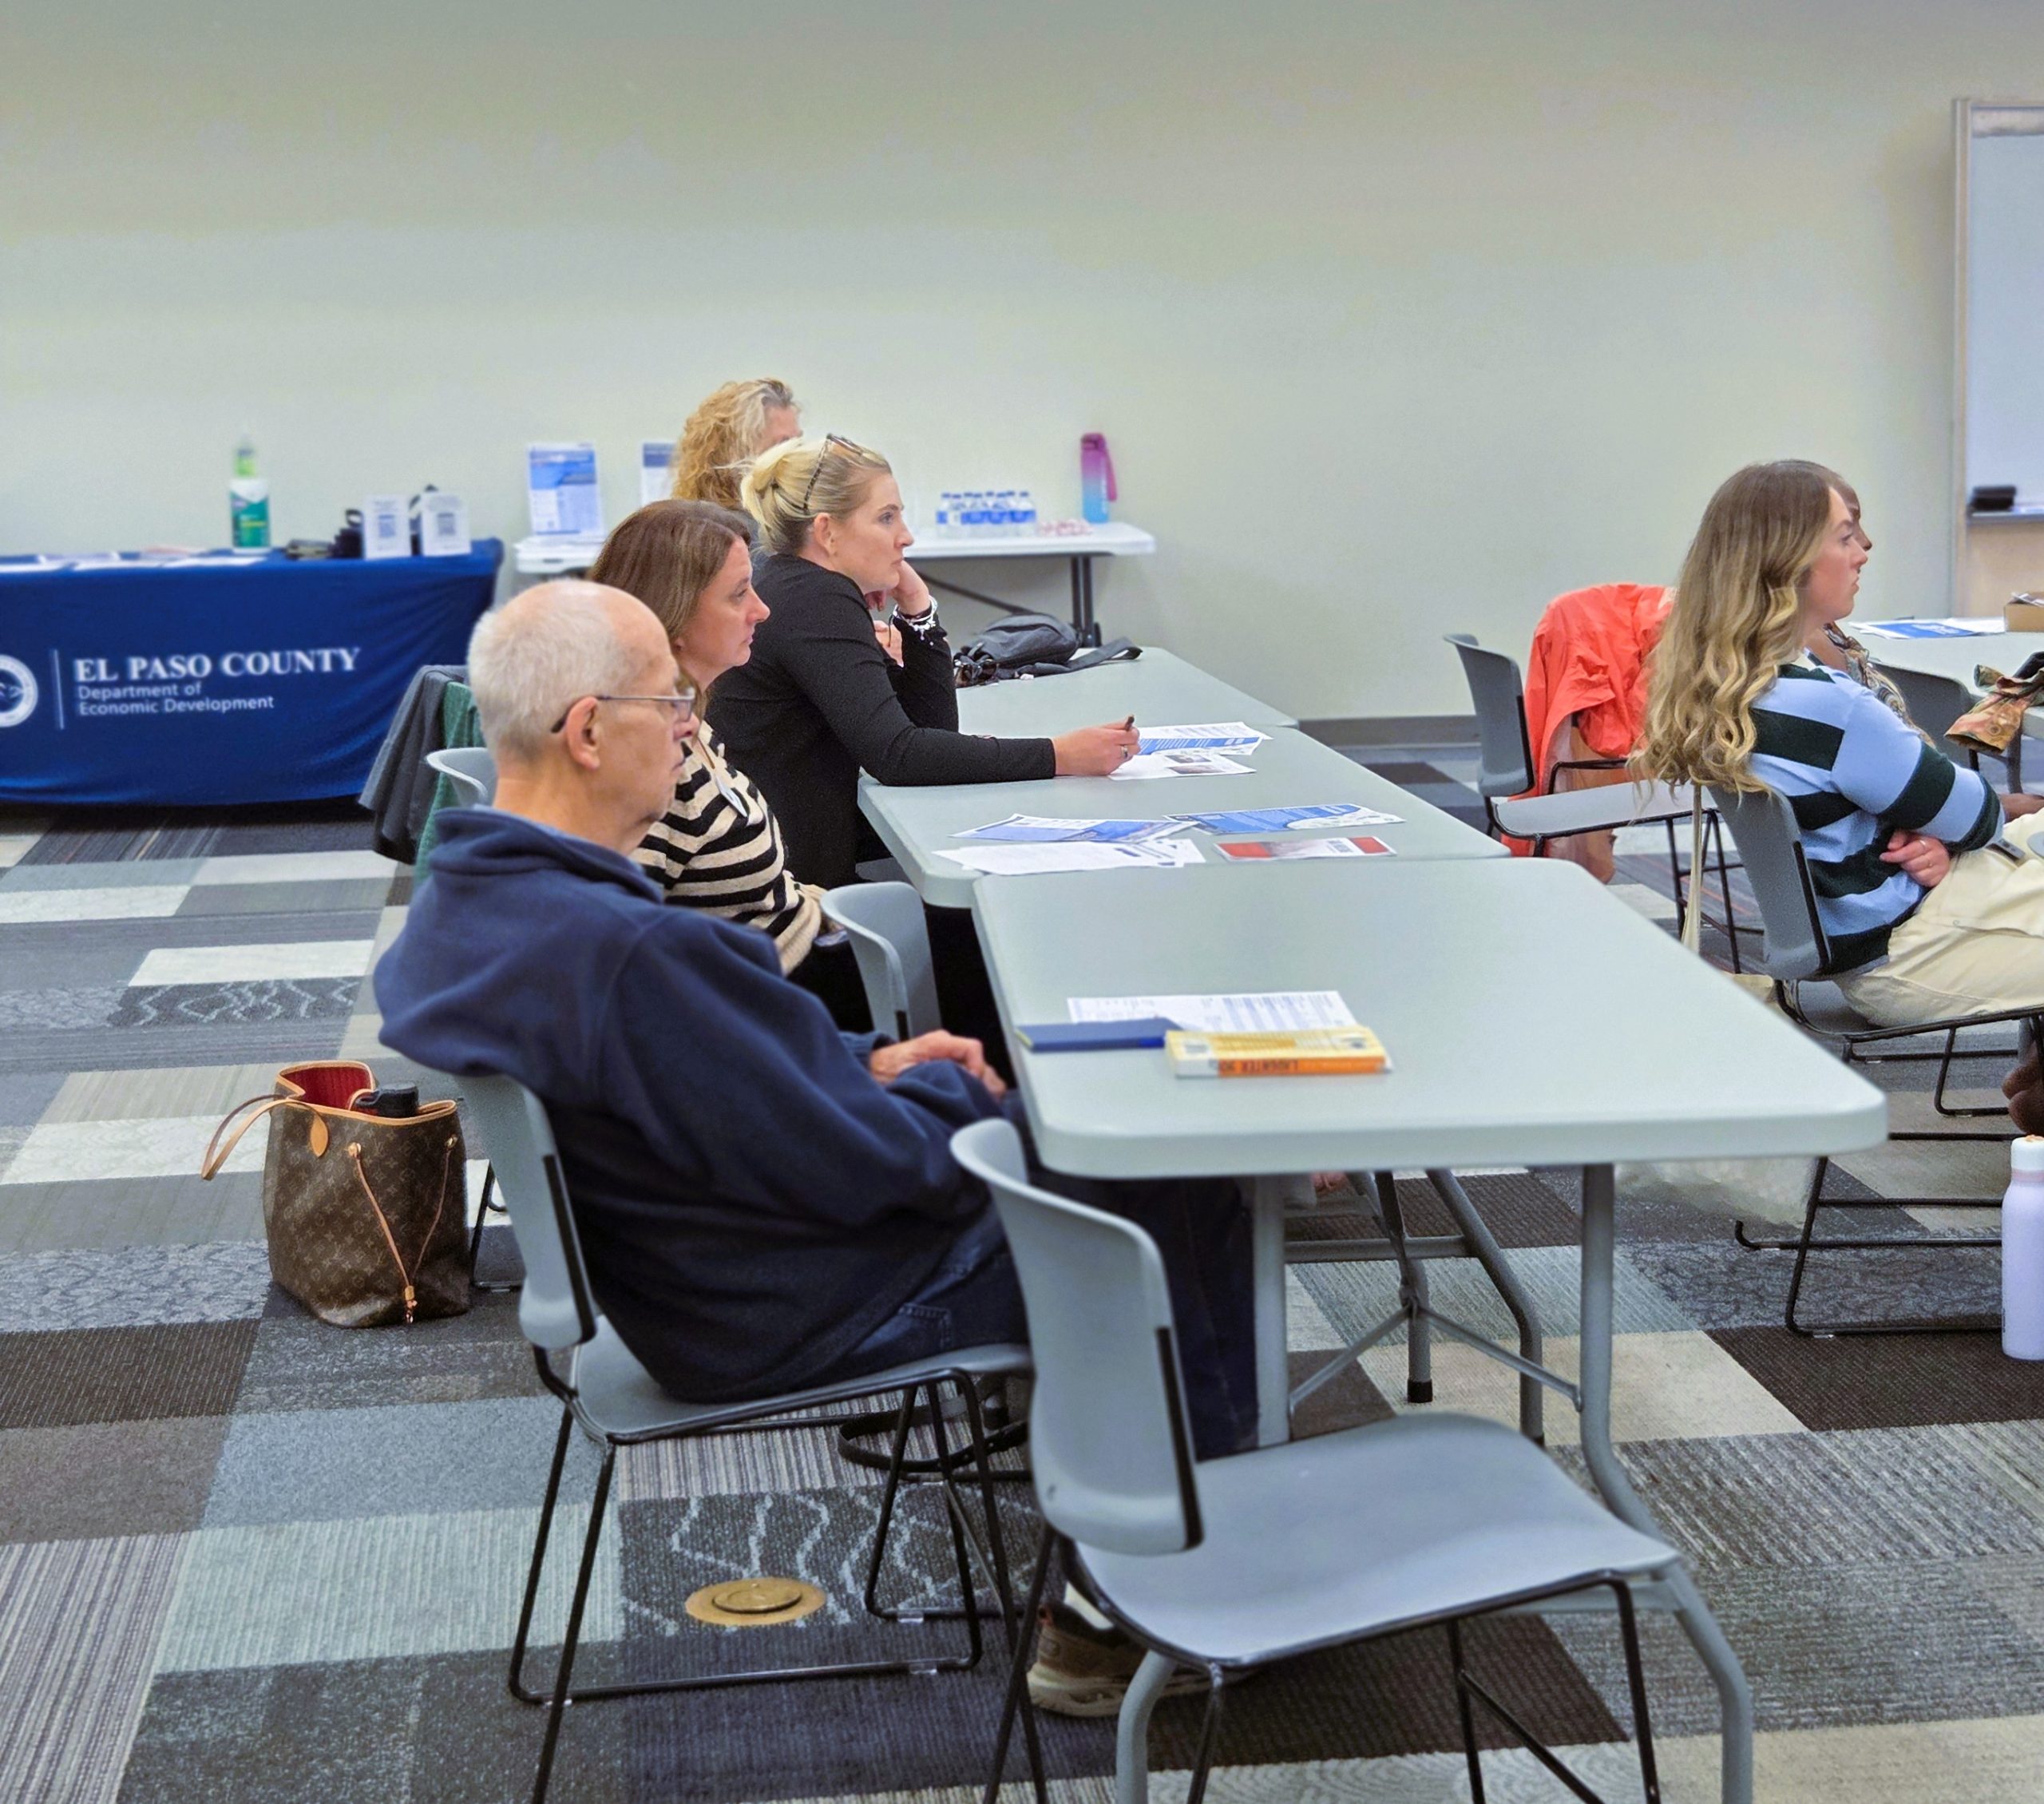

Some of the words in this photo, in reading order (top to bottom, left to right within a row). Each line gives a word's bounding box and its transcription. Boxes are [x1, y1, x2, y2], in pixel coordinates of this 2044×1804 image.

[74, 657, 119, 682] EL
[128, 654, 212, 680] PASO
[220, 647, 361, 677] COUNTY
[78, 684, 179, 701] Department
[184, 681, 202, 696] of
[79, 700, 159, 716] Economic
[164, 696, 275, 713] Development
